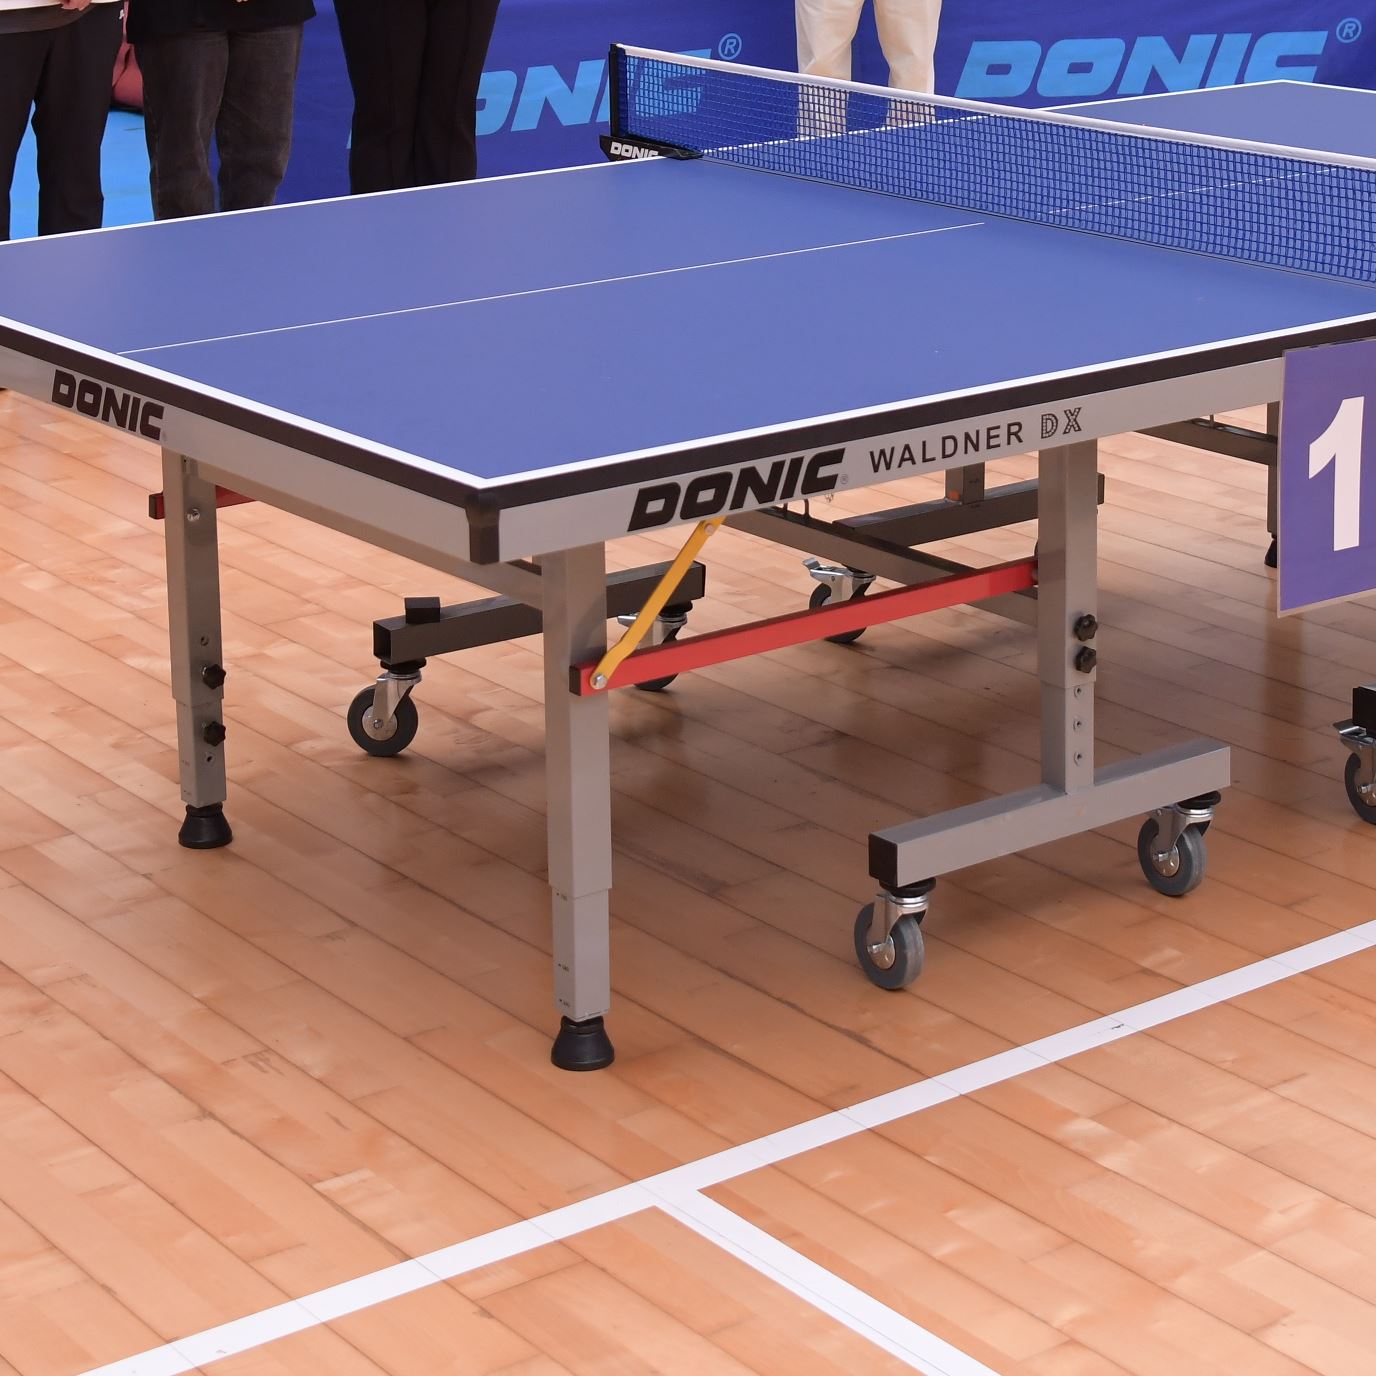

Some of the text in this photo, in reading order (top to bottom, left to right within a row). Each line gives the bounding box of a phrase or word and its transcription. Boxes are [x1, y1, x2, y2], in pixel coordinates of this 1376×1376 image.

[954, 30, 1328, 97] DONIC
[610, 141, 659, 159] DONIC
[51, 369, 165, 441] DONIC
[627, 408, 1082, 532] DONIC WALDNER DX
[1308, 395, 1366, 553] 1
